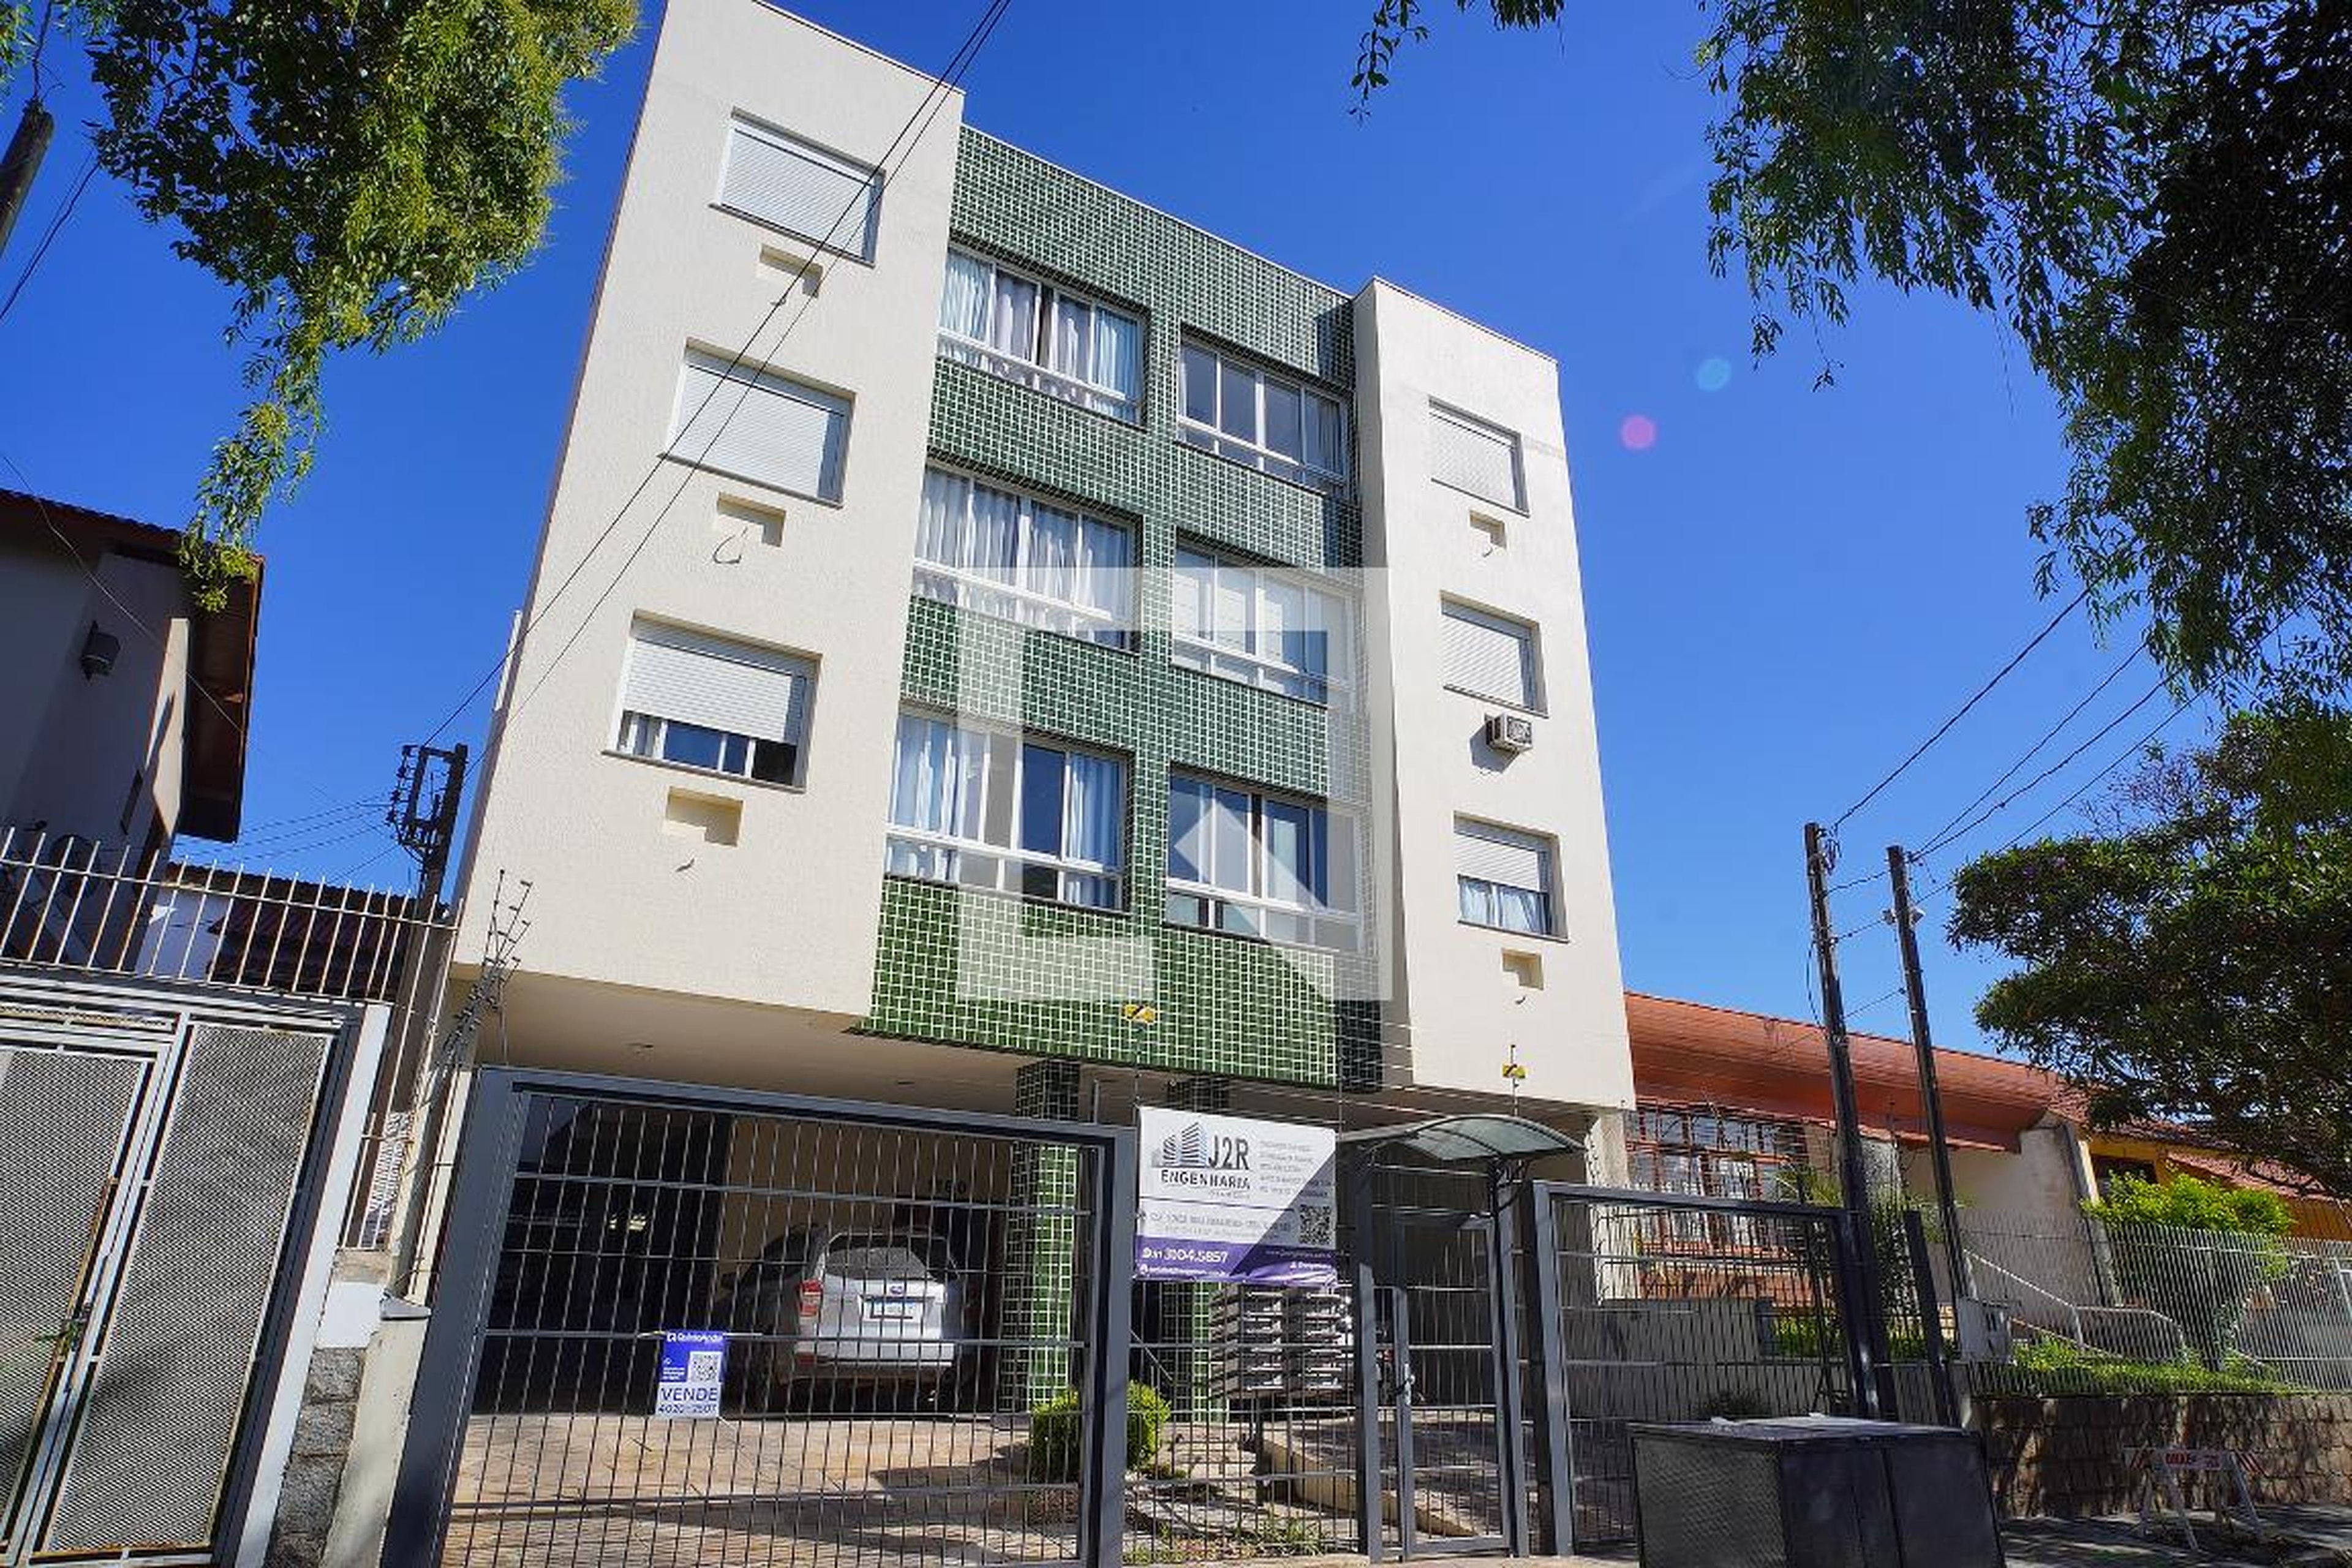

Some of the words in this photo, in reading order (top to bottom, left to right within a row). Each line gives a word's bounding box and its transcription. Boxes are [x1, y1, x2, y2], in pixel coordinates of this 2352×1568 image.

[1208, 1135, 1250, 1170] J2R
[1161, 1169, 1251, 1190] ENGENHARIA
[660, 1387, 718, 1401] VENDE
